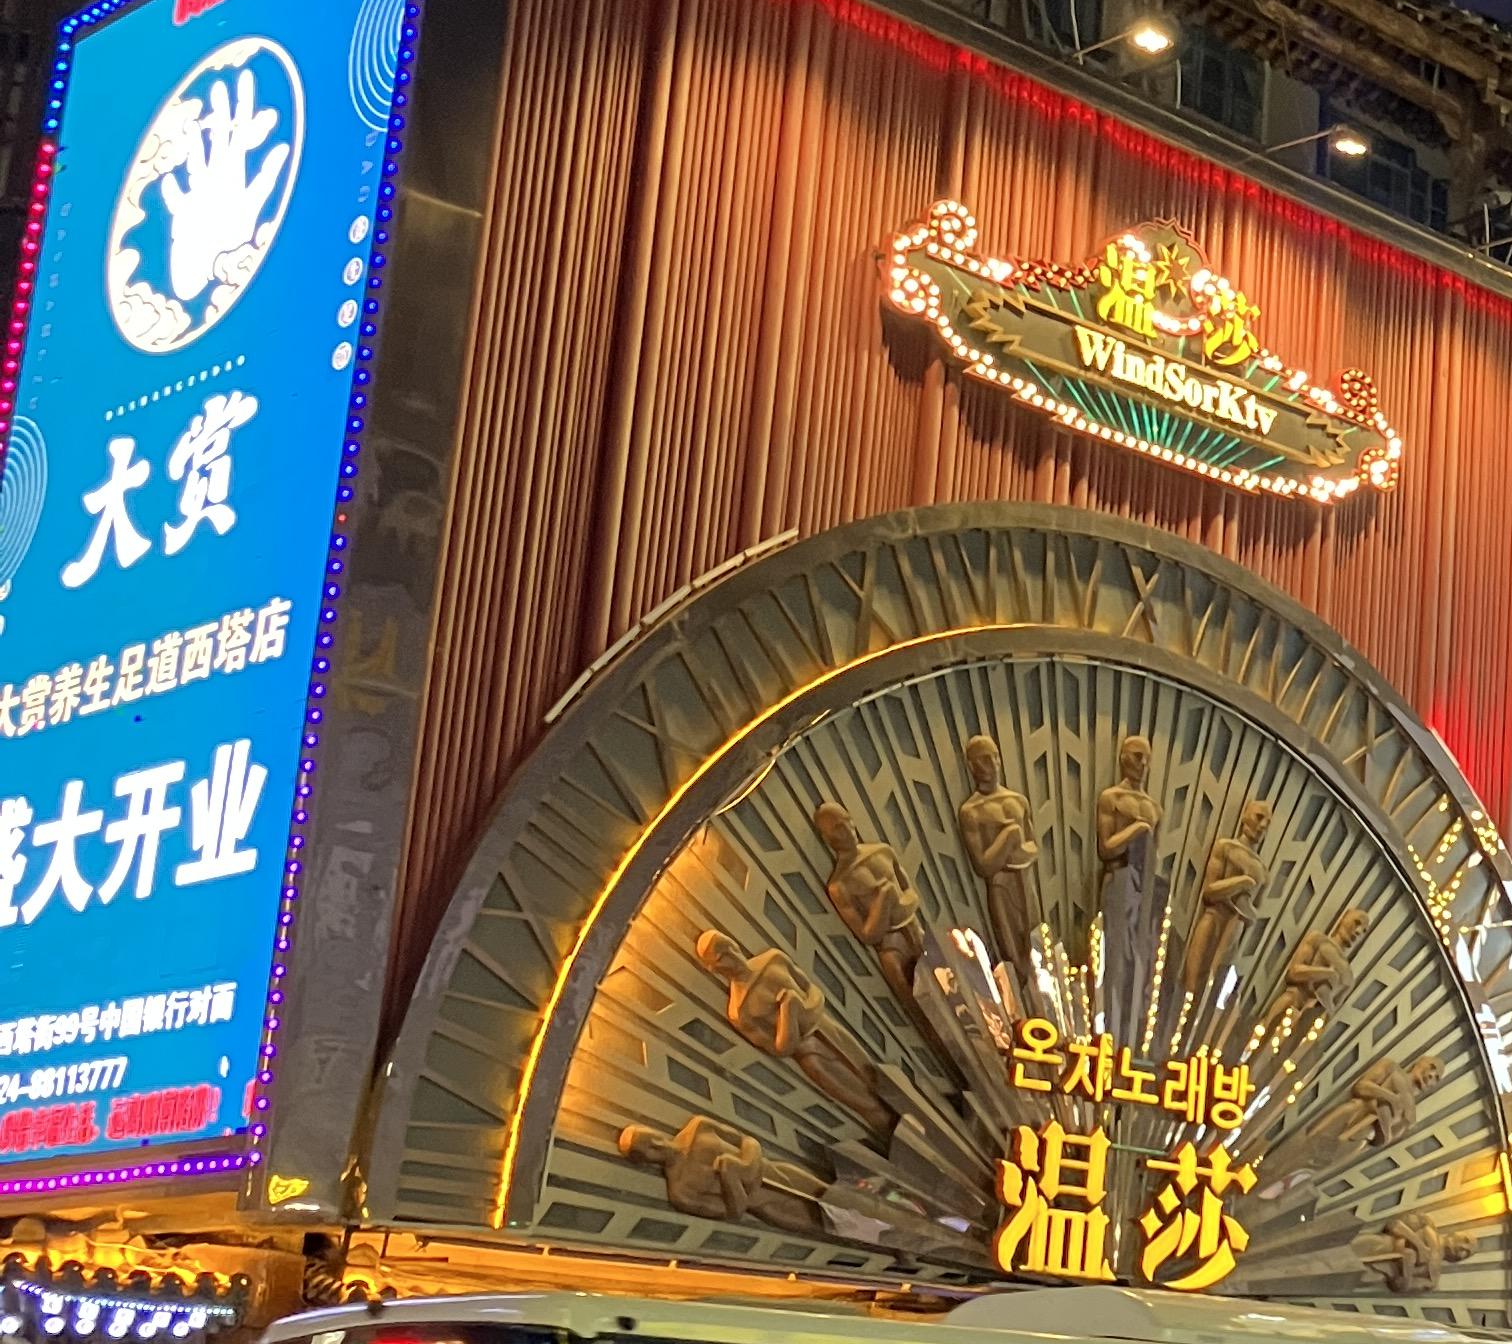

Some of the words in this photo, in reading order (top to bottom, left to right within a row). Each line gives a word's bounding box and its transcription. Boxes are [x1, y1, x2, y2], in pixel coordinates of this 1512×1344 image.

[1098, 239, 1262, 366] 温莎
[62, 391, 258, 588] 大赏
[0, 597, 292, 737] 大赏养生足道西塔店
[998, 1120, 1259, 1290] 温莎
